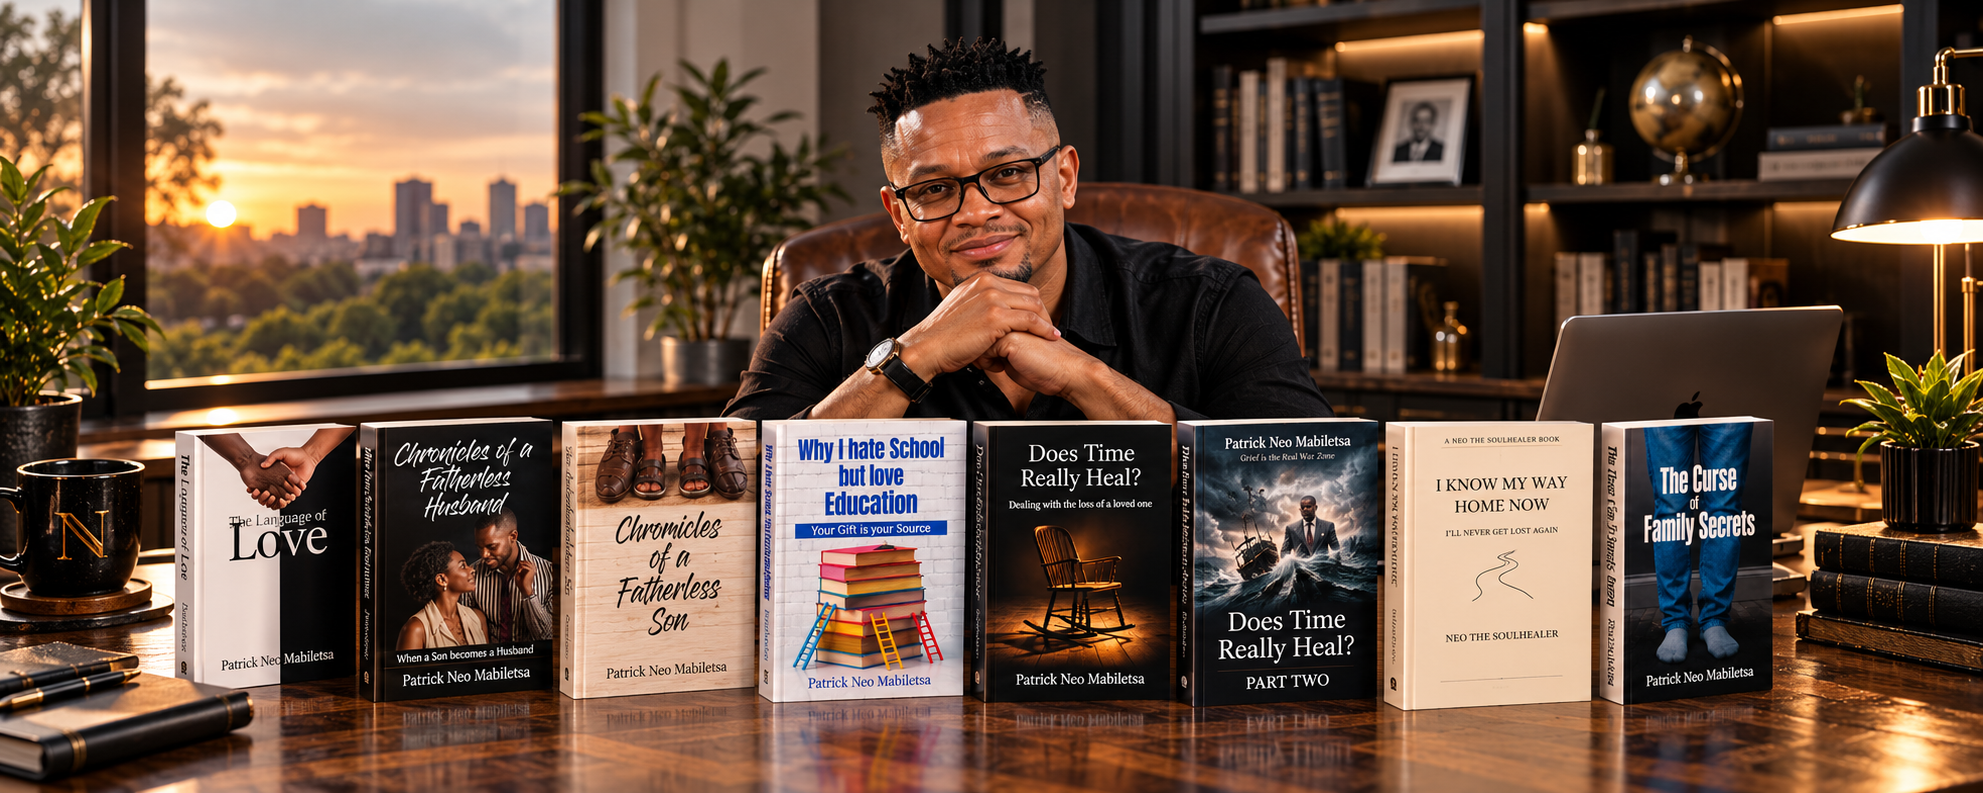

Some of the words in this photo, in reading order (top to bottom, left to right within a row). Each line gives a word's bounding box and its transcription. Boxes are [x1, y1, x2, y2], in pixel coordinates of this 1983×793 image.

[394, 439, 490, 468] Chronicles
[496, 437, 517, 467] of
[520, 443, 533, 458] a
[798, 439, 833, 463] Why
[838, 439, 844, 460] I
[848, 438, 884, 459] hate
[889, 436, 944, 458] School
[1224, 436, 1266, 449] Patrick
[1269, 436, 1292, 448] Neo
[1296, 435, 1351, 447] Mabiletsa
[1029, 445, 1078, 463] Does
[1084, 444, 1135, 462] Time
[420, 464, 511, 493] Fatherless
[838, 465, 865, 487] but
[869, 464, 904, 486] love
[1021, 469, 1079, 491] Really
[1086, 468, 1141, 487] Heal?
[1436, 479, 1441, 492] I
[1446, 478, 1498, 491] KNOW
[1502, 477, 1527, 490] MY
[1532, 476, 1567, 489] WAY
[1660, 467, 1688, 495] The
[1692, 465, 1737, 492] Curse
[424, 492, 510, 522] Husband
[825, 491, 917, 516] Education
[1009, 500, 1040, 510] Dealing
[1041, 500, 1061, 509] with
[1063, 500, 1076, 508] the
[1079, 500, 1095, 508] loss
[1096, 499, 1105, 508] of
[1113, 499, 1136, 508] loved
[1455, 499, 1505, 513] HOME
[1509, 498, 1549, 511] NOW
[1690, 496, 1699, 510] of
[229, 516, 252, 528] The
[257, 513, 312, 527] Language
[315, 509, 327, 521] of
[1644, 513, 1695, 546] Family
[1699, 511, 1755, 539] Secrets
[55, 510, 109, 560] N
[811, 524, 835, 536] Your
[838, 524, 857, 535] Gift
[860, 524, 869, 534] is
[871, 524, 894, 537] your
[896, 523, 931, 534] Source
[229, 523, 328, 561] Love
[649, 543, 672, 574] of
[677, 550, 691, 568] a
[616, 572, 721, 609] Fatherless
[648, 606, 689, 636] Son
[1228, 611, 1283, 632] Does
[1289, 609, 1346, 630] Time
[1446, 634, 1466, 643] NEO
[1469, 632, 1490, 642] THE
[1492, 630, 1559, 641] SOULHEALER
[221, 655, 258, 671] Patrick
[260, 656, 281, 668] Neo
[284, 649, 334, 664] Mabiletsa
[397, 652, 423, 664] When
[431, 652, 448, 661] Son
[450, 649, 488, 660] becomes
[496, 644, 534, 657] Husband
[1218, 637, 1287, 664] Really
[1292, 635, 1354, 657] Heal?
[402, 669, 444, 688] Patrick
[447, 670, 471, 684] Neo
[474, 666, 531, 682] Mabiletsa
[606, 664, 645, 679] Patrick
[649, 664, 672, 677] Neo
[674, 661, 727, 676] Mabiletsa
[1016, 673, 1057, 686] Patrick
[1060, 673, 1084, 685] Neo
[1087, 672, 1145, 685] Mabiletsa
[1646, 672, 1681, 687] Patrick
[1683, 671, 1704, 684] Neo
[1706, 666, 1754, 681] Mabiletsa
[808, 676, 848, 689] Patrick
[851, 677, 874, 688] Neo
[877, 674, 931, 688] Mabiletsa
[1246, 676, 1287, 690] PART
[1291, 674, 1330, 688] TWO
